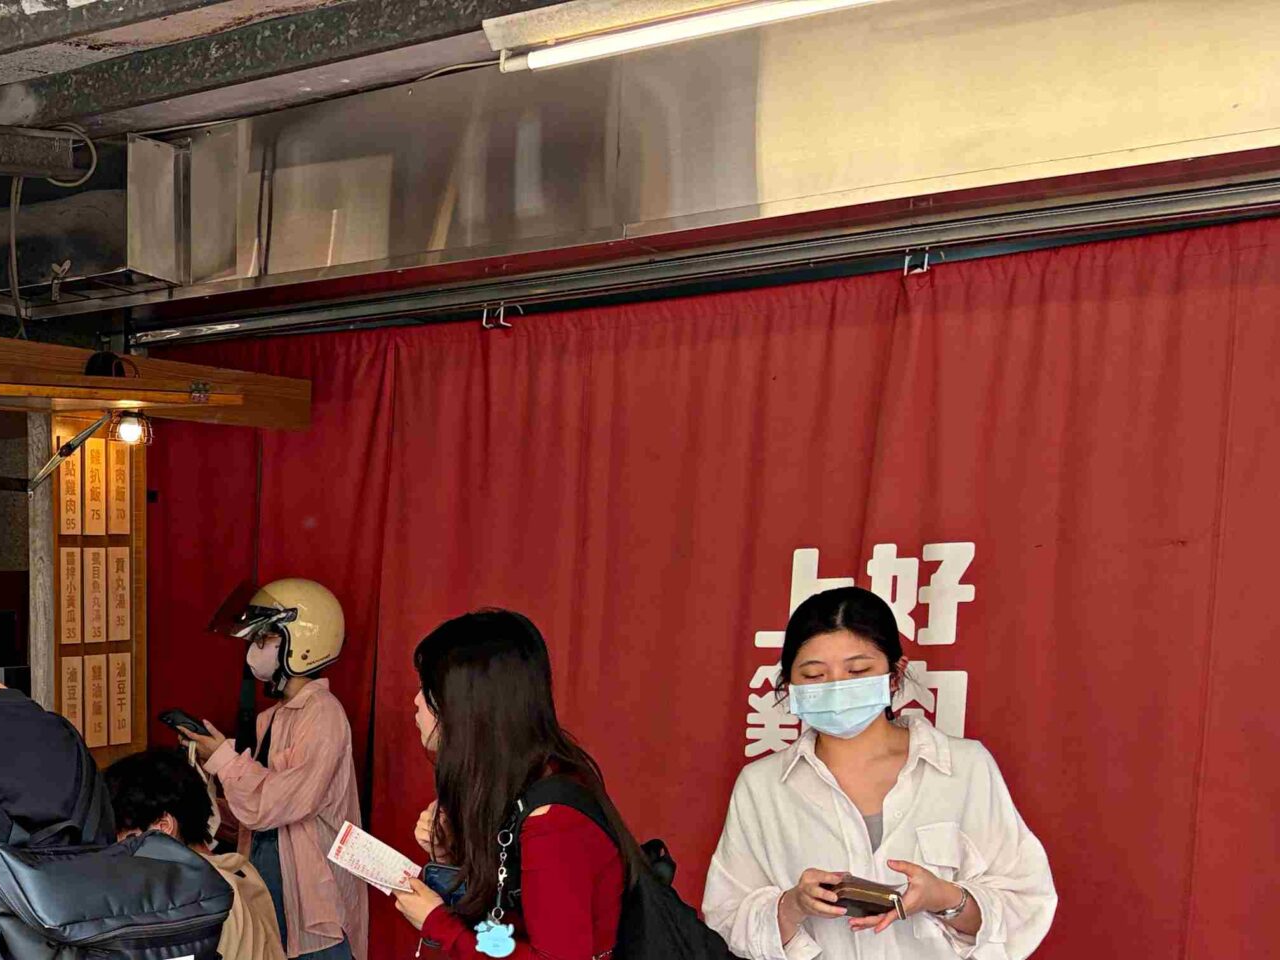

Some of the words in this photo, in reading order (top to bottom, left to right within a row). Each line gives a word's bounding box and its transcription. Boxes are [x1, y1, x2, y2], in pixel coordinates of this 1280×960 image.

[64, 460, 76, 514] 點雞肉
[91, 509, 101, 520] 75
[65, 518, 76, 530] 95
[755, 542, 976, 648] 上好
[116, 615, 126, 626] 35
[66, 627, 76, 639] 35
[92, 626, 102, 638] 35
[93, 722, 102, 733] 15
[117, 719, 126, 730] 10
